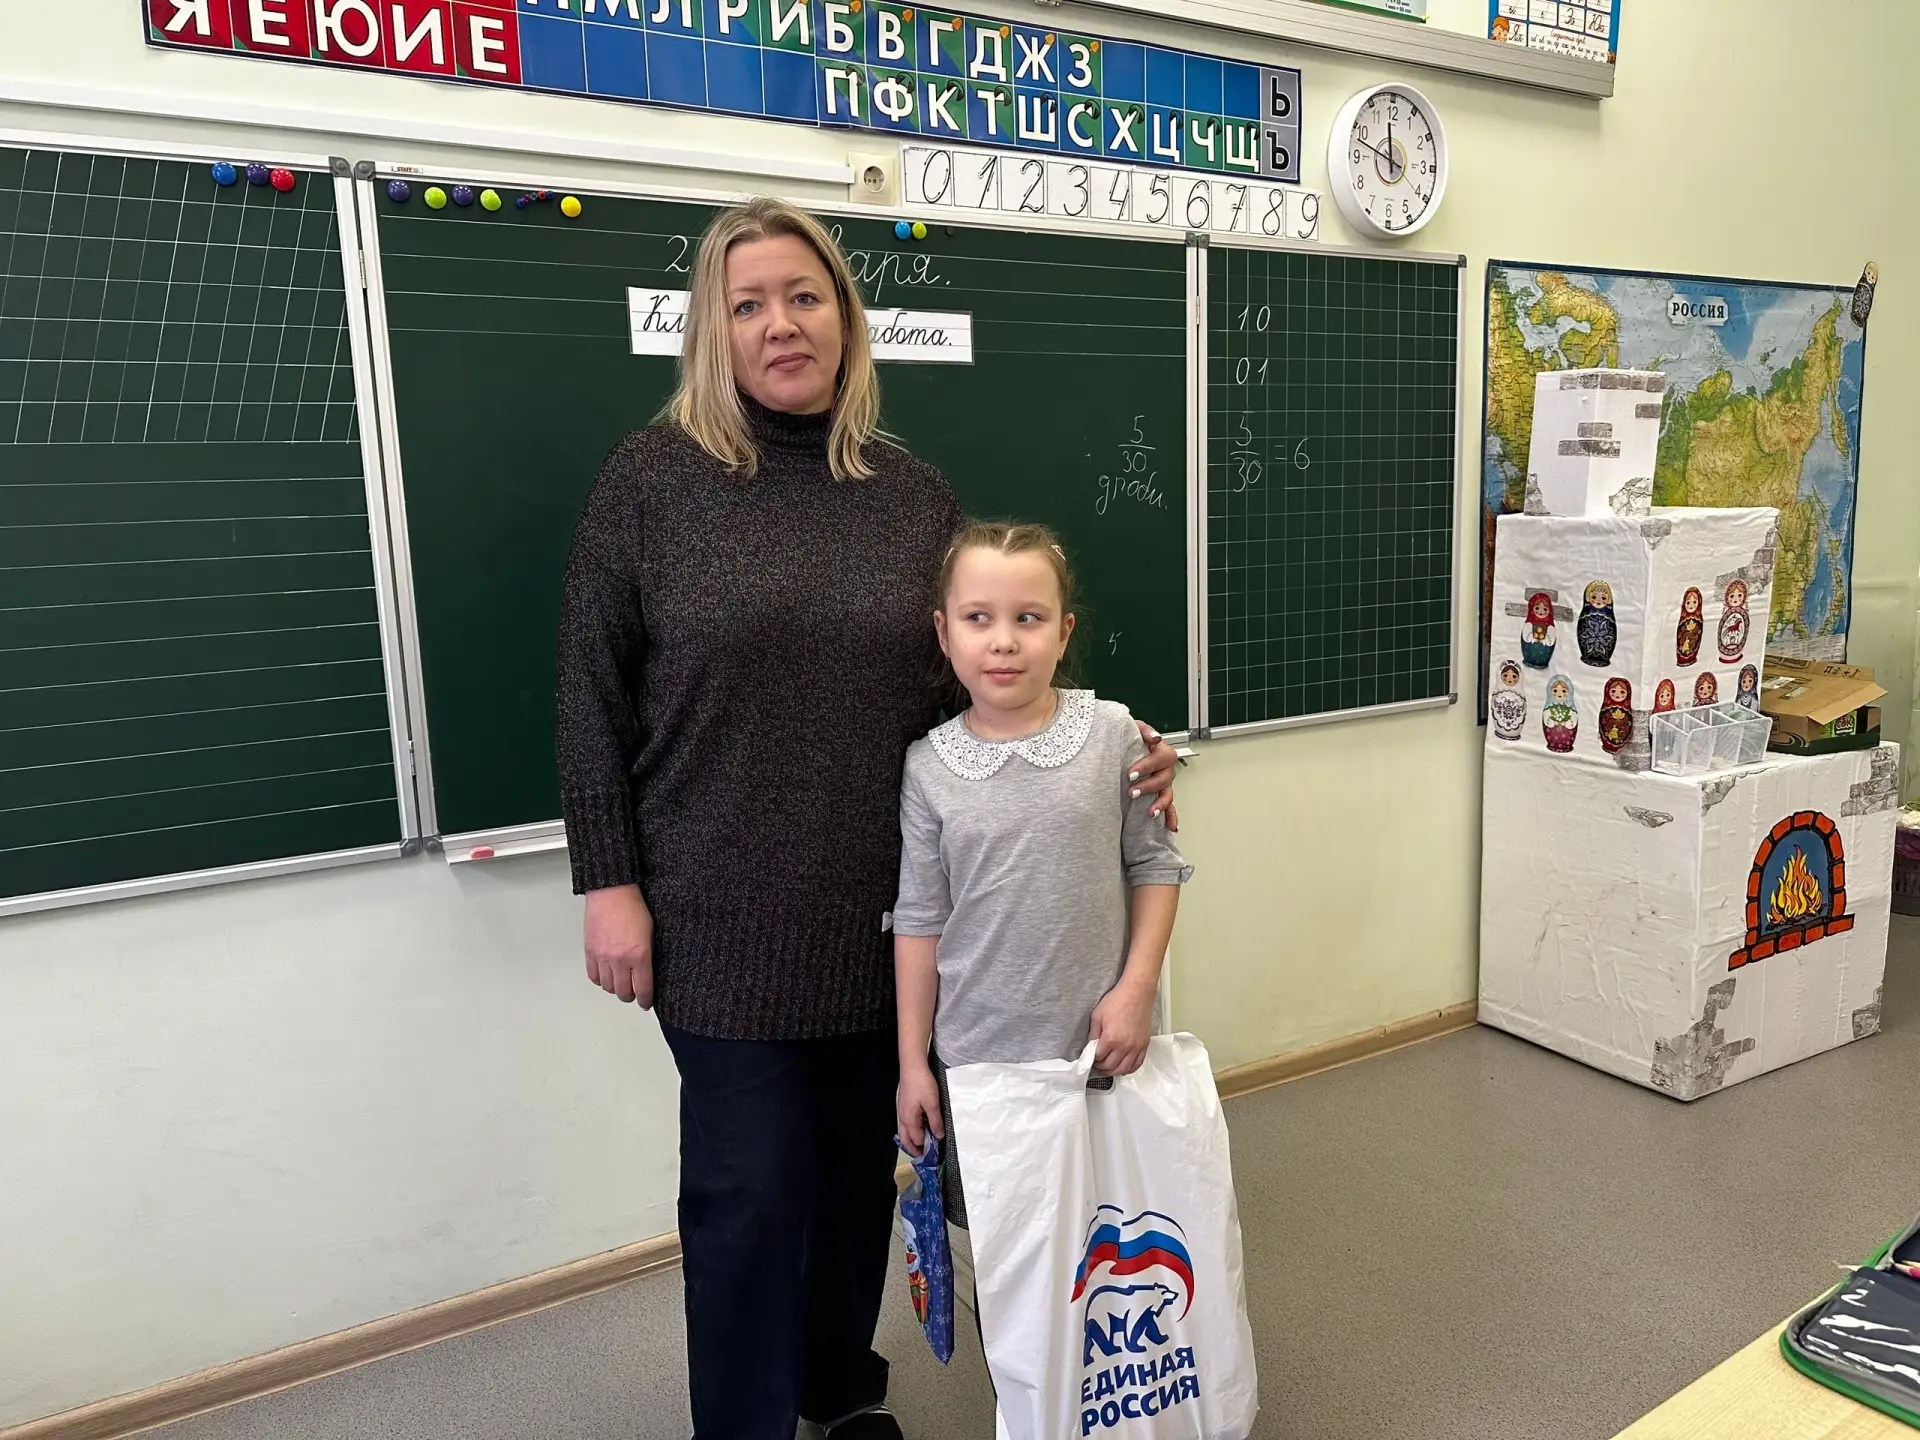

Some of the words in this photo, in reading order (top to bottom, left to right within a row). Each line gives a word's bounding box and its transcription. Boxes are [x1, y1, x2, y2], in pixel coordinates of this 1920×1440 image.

[315, 0, 380, 57] Ю
[391, 4, 445, 66] И
[469, 15, 508, 74] Е
[824, 2, 854, 53] Б
[878, 10, 905, 60] В
[929, 19, 956, 67] Г
[969, 26, 1007, 83] Д
[1014, 32, 1057, 84] Ж
[1066, 43, 1093, 89] З
[1270, 75, 1292, 119] Ь
[824, 67, 860, 119] П
[872, 77, 914, 123] Ф
[927, 82, 961, 132] К
[977, 89, 1006, 137] Т
[1016, 94, 1057, 144] Ш
[1066, 102, 1094, 148] С
[1109, 107, 1139, 153] Х
[1153, 112, 1180, 163] Ц
[1191, 119, 1215, 163] Ч
[1225, 123, 1261, 174] Щ
[1264, 129, 1291, 171] Ъ
[1372, 109, 1381, 124] 11
[1387, 105, 1399, 121] 12
[1406, 116, 1412, 130] 1
[1357, 125, 1368, 140] 10
[1416, 135, 1424, 150] 2
[1353, 149, 1361, 164] 9
[1420, 160, 1427, 174] 3
[1357, 174, 1364, 189] 8
[922, 150, 951, 204] 0
[978, 156, 998, 208] 1
[1018, 159, 1044, 212] 2
[1063, 165, 1088, 216] 3
[1109, 170, 1129, 220] 4
[1146, 174, 1170, 223] 5
[1186, 180, 1210, 229] 6
[1225, 184, 1247, 232] 7
[1261, 189, 1284, 235] 8
[1297, 194, 1319, 238] 9
[1414, 184, 1422, 198] 4
[1369, 194, 1376, 209] 7
[1385, 203, 1392, 217] 6
[1402, 199, 1409, 213] 5
[1672, 301, 1725, 320] РОССИЯ
[1130, 415, 1146, 444] 5
[1234, 411, 1256, 447] 5
[1122, 450, 1147, 473] 30
[1294, 437, 1311, 470] 6
[1233, 456, 1263, 493] 30
[1081, 1346, 1196, 1406] ЕДИНАЯ
[1081, 1374, 1201, 1438] РОССИЯ
